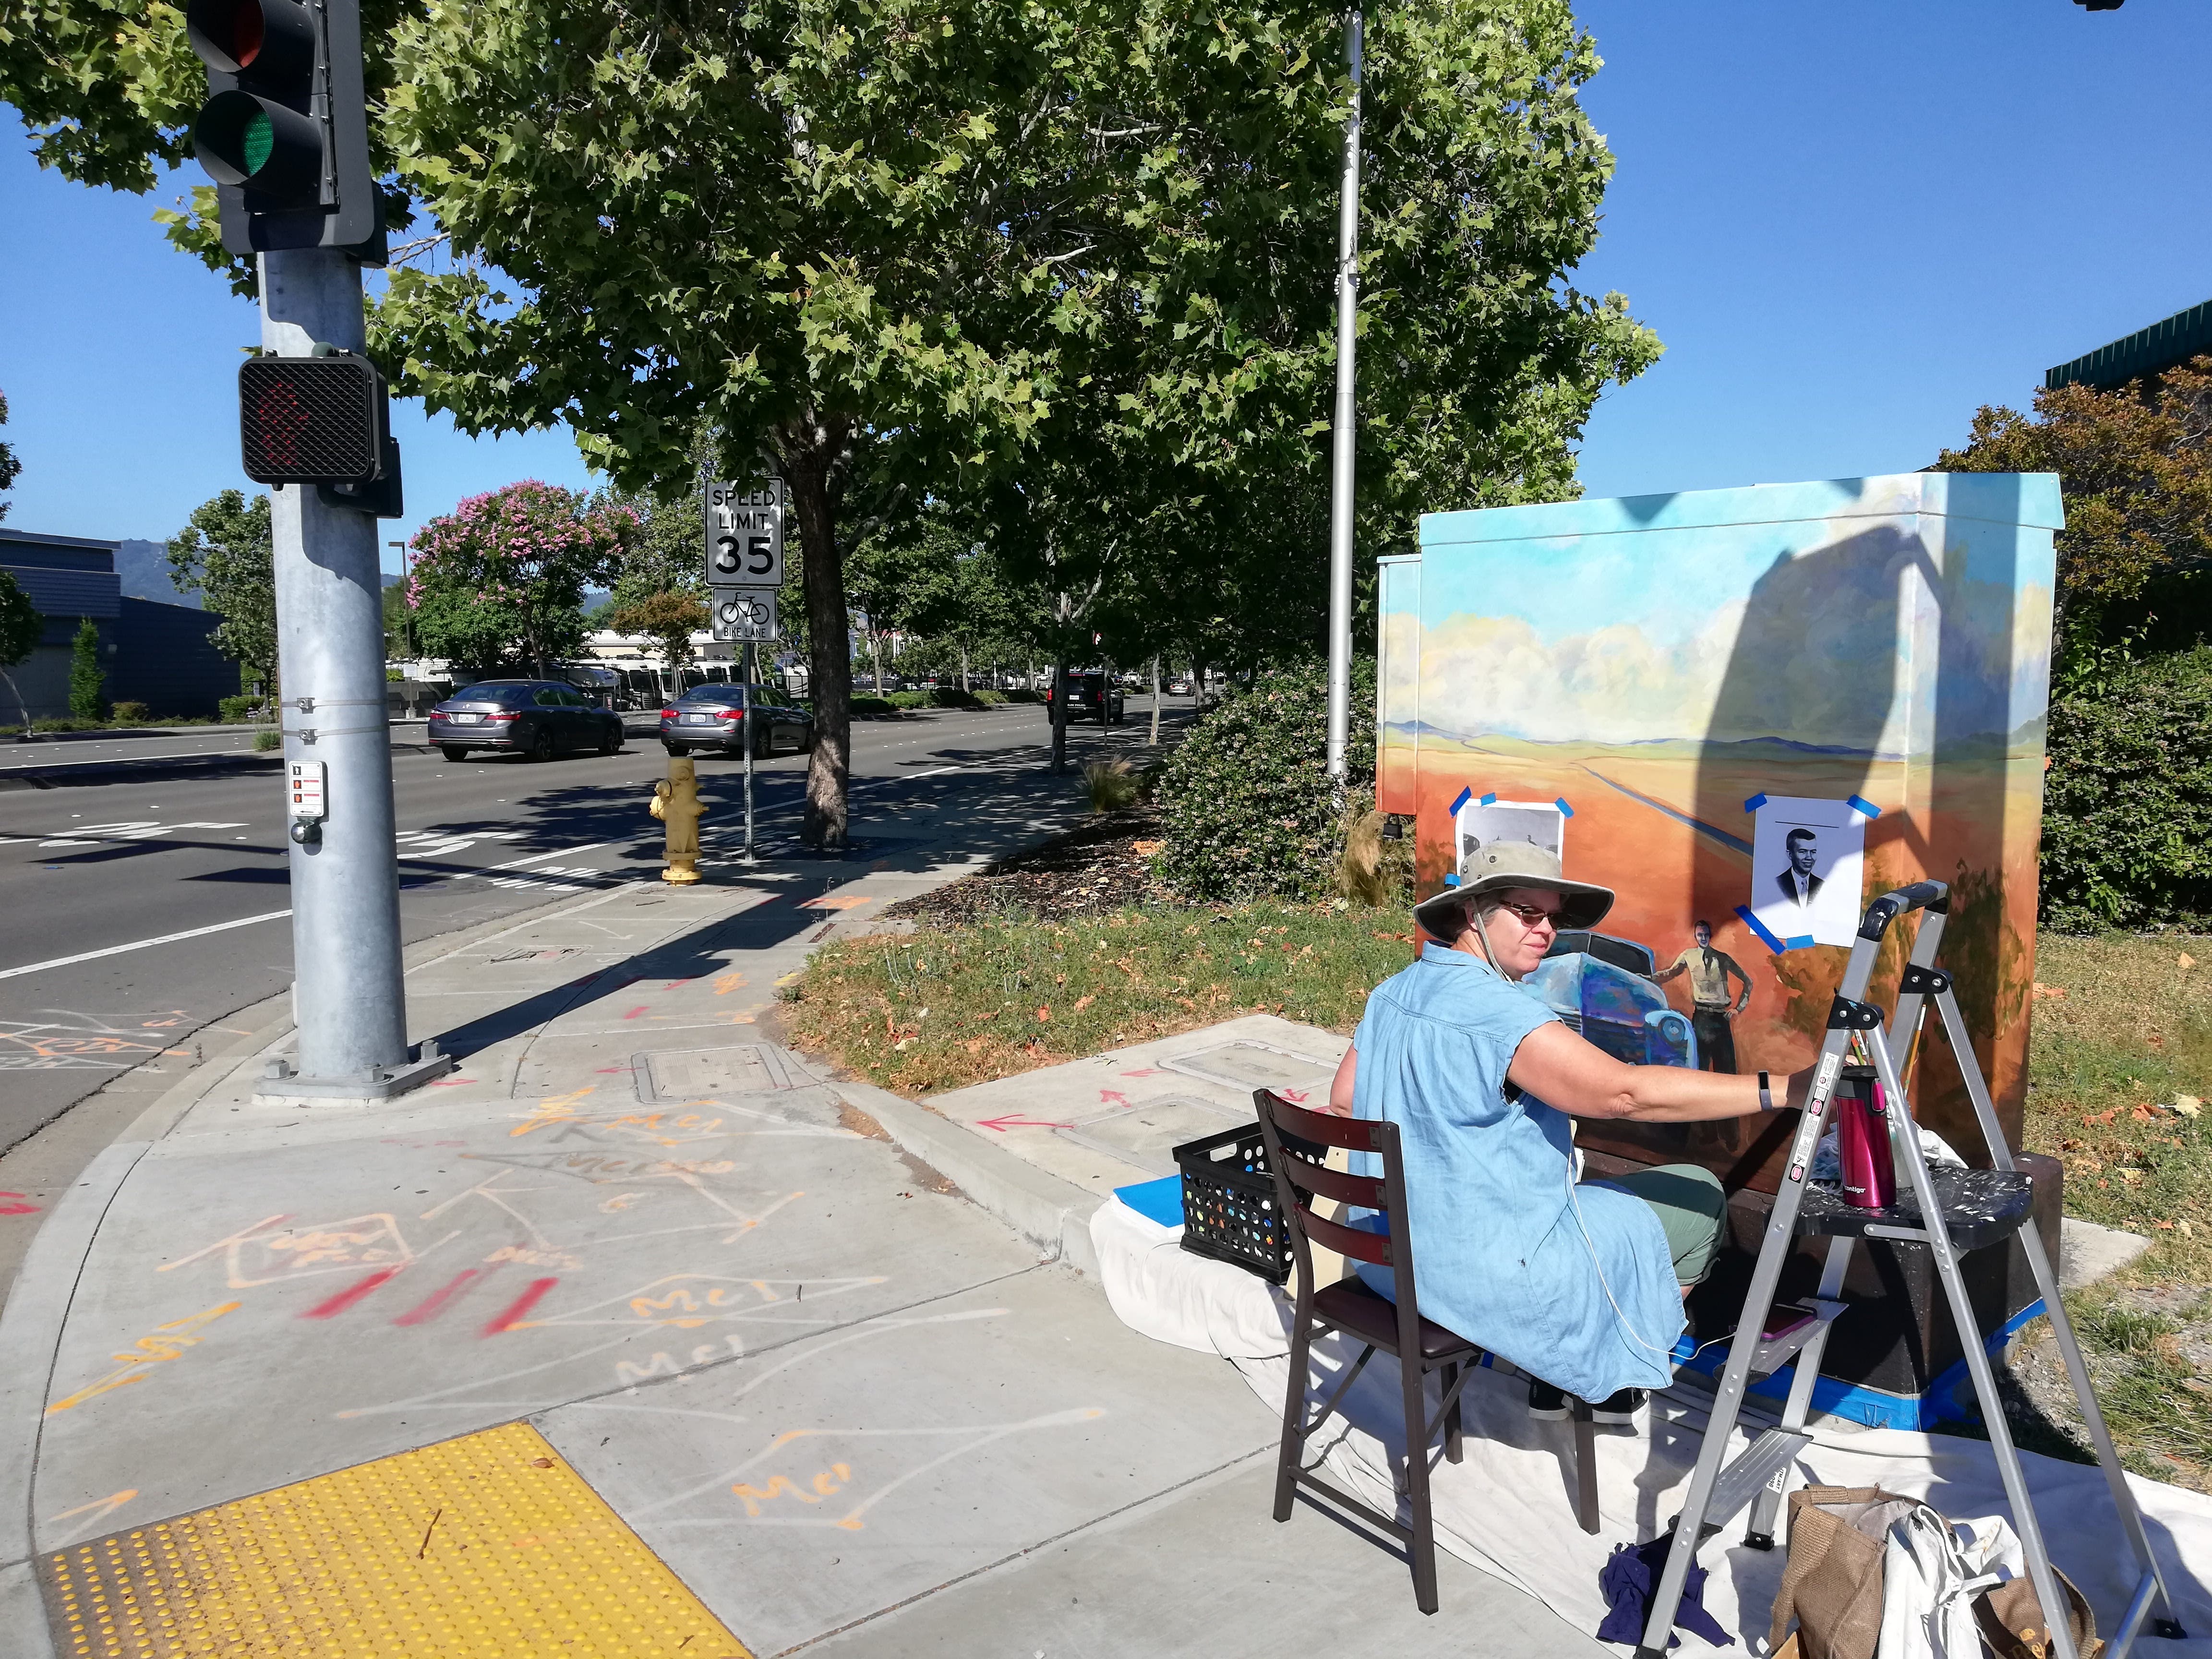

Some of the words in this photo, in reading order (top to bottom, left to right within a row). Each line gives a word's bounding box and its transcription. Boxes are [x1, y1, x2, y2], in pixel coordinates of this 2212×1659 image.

[712, 490, 775, 506] SPEED
[719, 513, 769, 529] LIMIT
[716, 536, 773, 575] 35
[724, 627, 741, 637] BIKE
[745, 628, 766, 638] LANE
